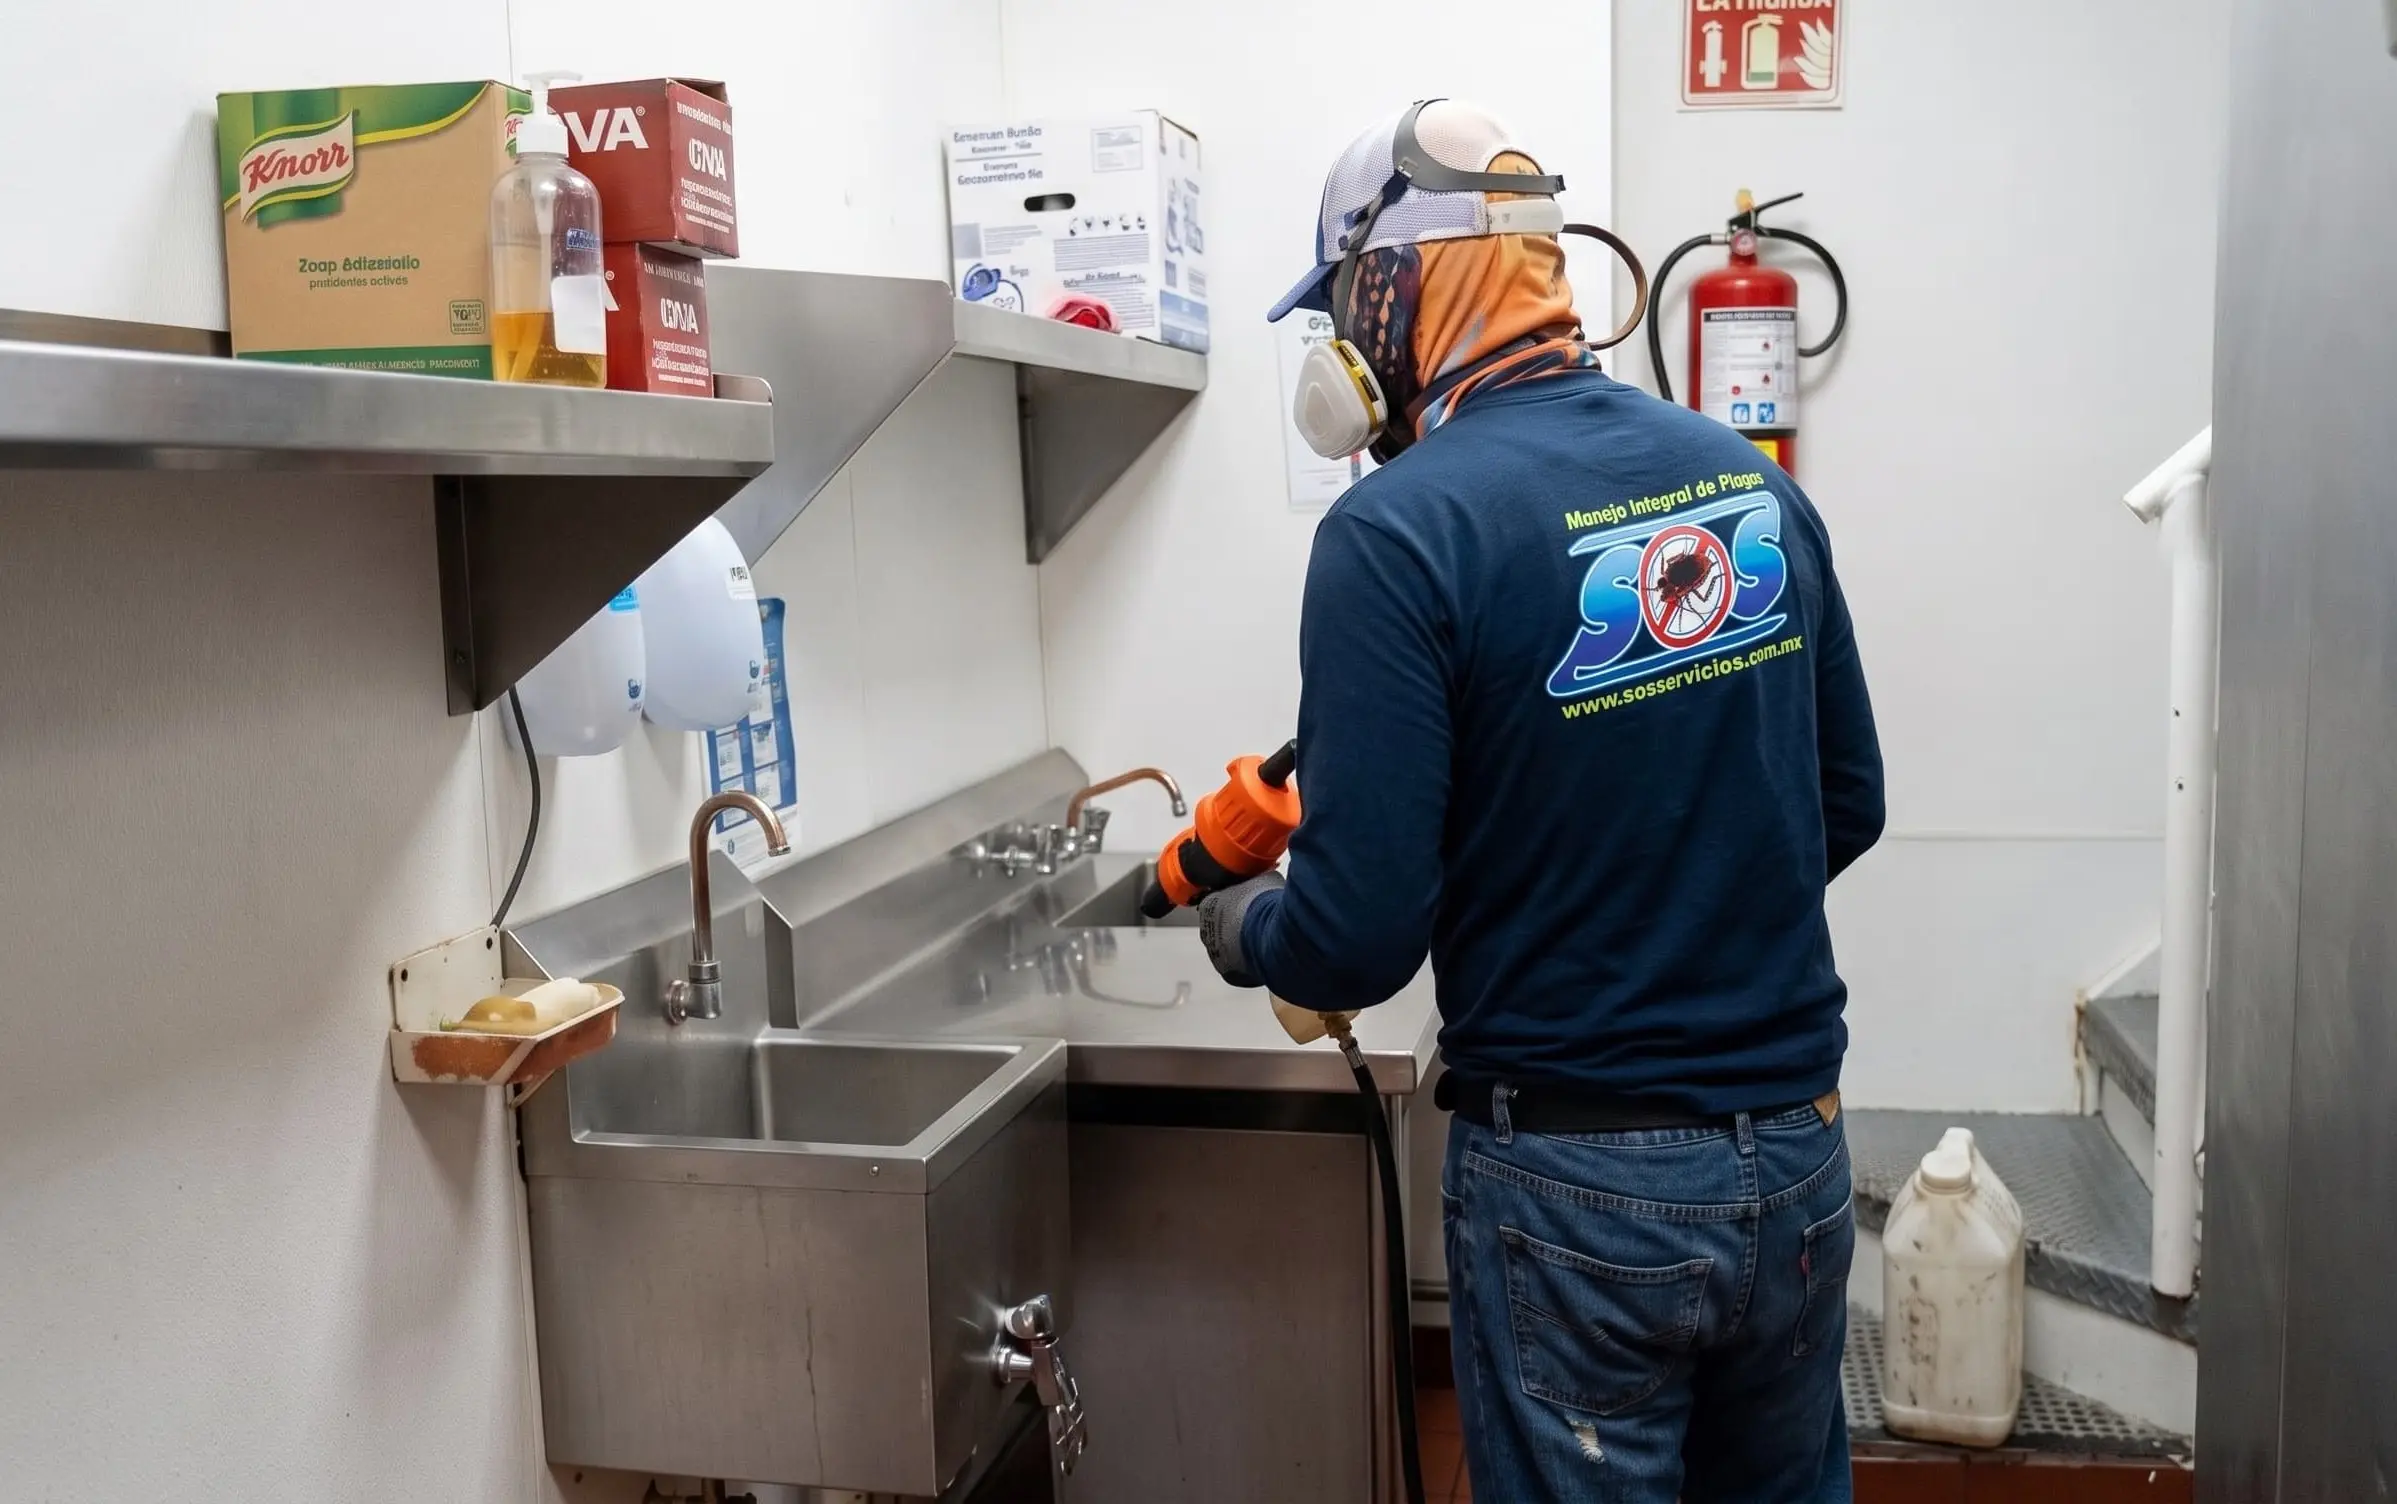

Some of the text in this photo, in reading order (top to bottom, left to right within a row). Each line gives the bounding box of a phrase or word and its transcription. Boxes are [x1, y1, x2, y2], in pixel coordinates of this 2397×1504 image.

[243, 142, 350, 193] Knorr
[1565, 504, 1628, 530] Manejo
[1629, 484, 1693, 516] Integral
[1696, 479, 1717, 498] de
[1561, 634, 1804, 720] www.sosservicios.com.mx
